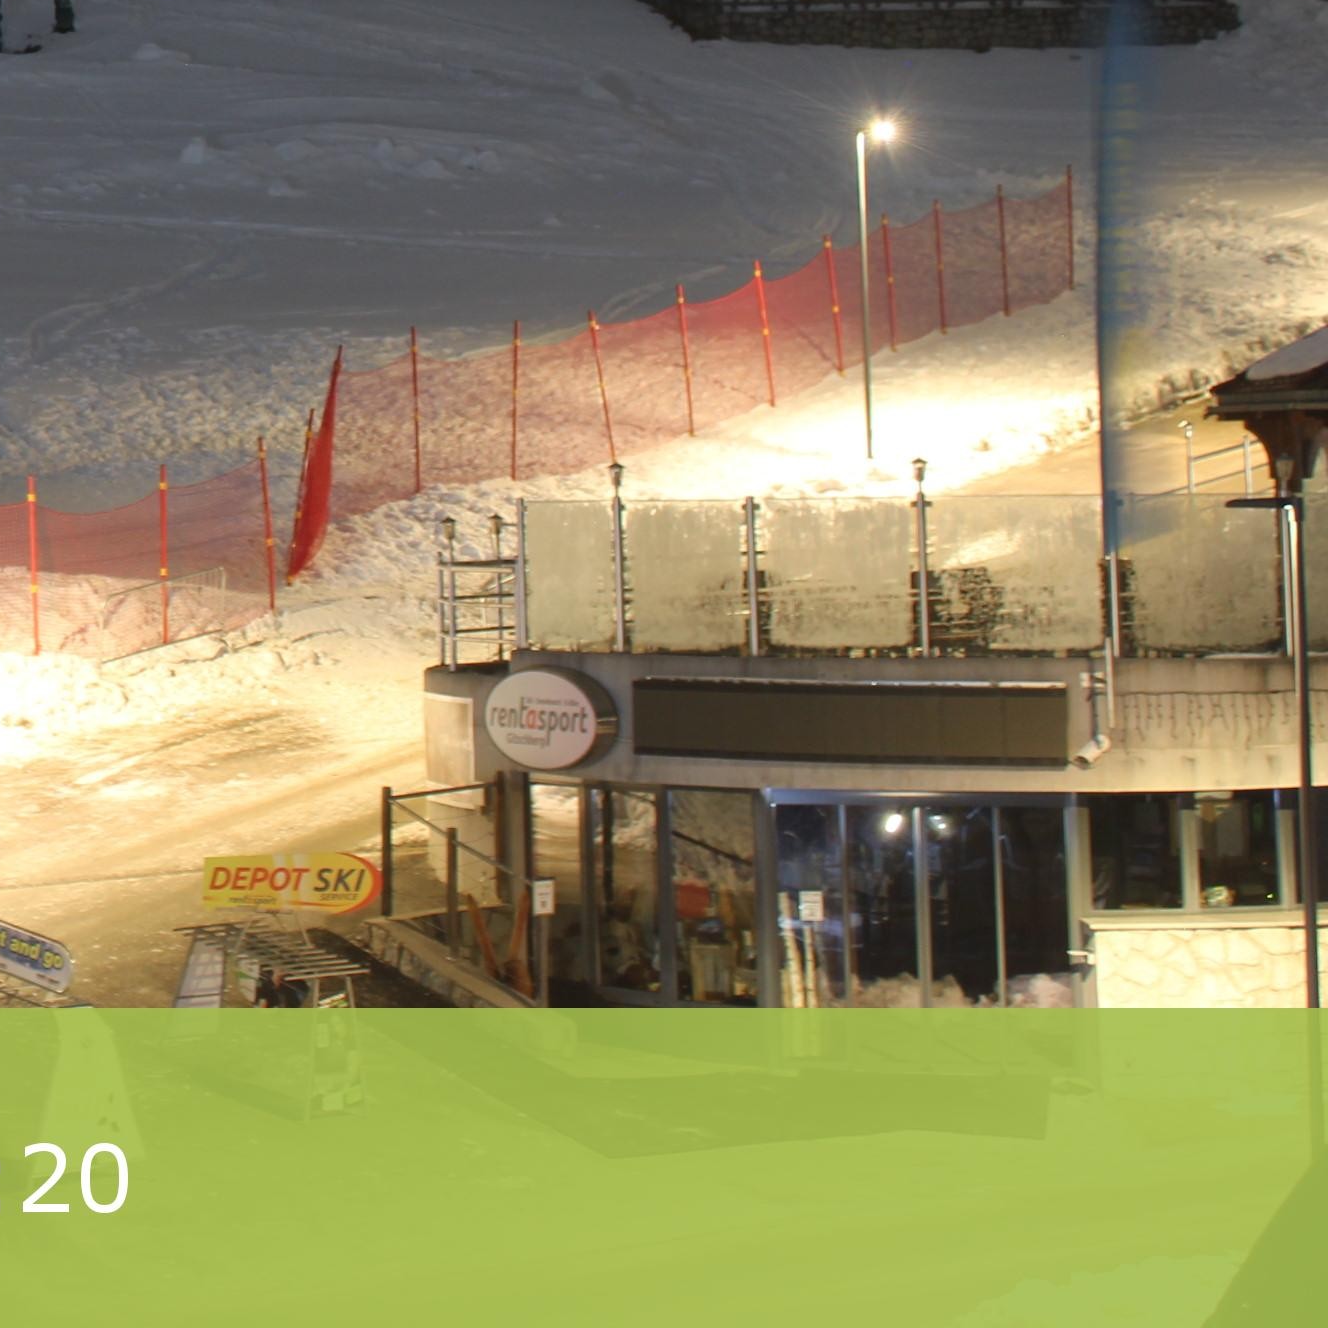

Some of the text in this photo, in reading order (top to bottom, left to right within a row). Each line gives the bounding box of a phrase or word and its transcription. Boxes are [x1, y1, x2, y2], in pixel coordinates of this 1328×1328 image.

[491, 696, 588, 746] rentasport
[209, 867, 366, 892] DEPOT SKI
[320, 893, 360, 901] SERVICE
[9, 937, 42, 960] and
[42, 950, 65, 970] go
